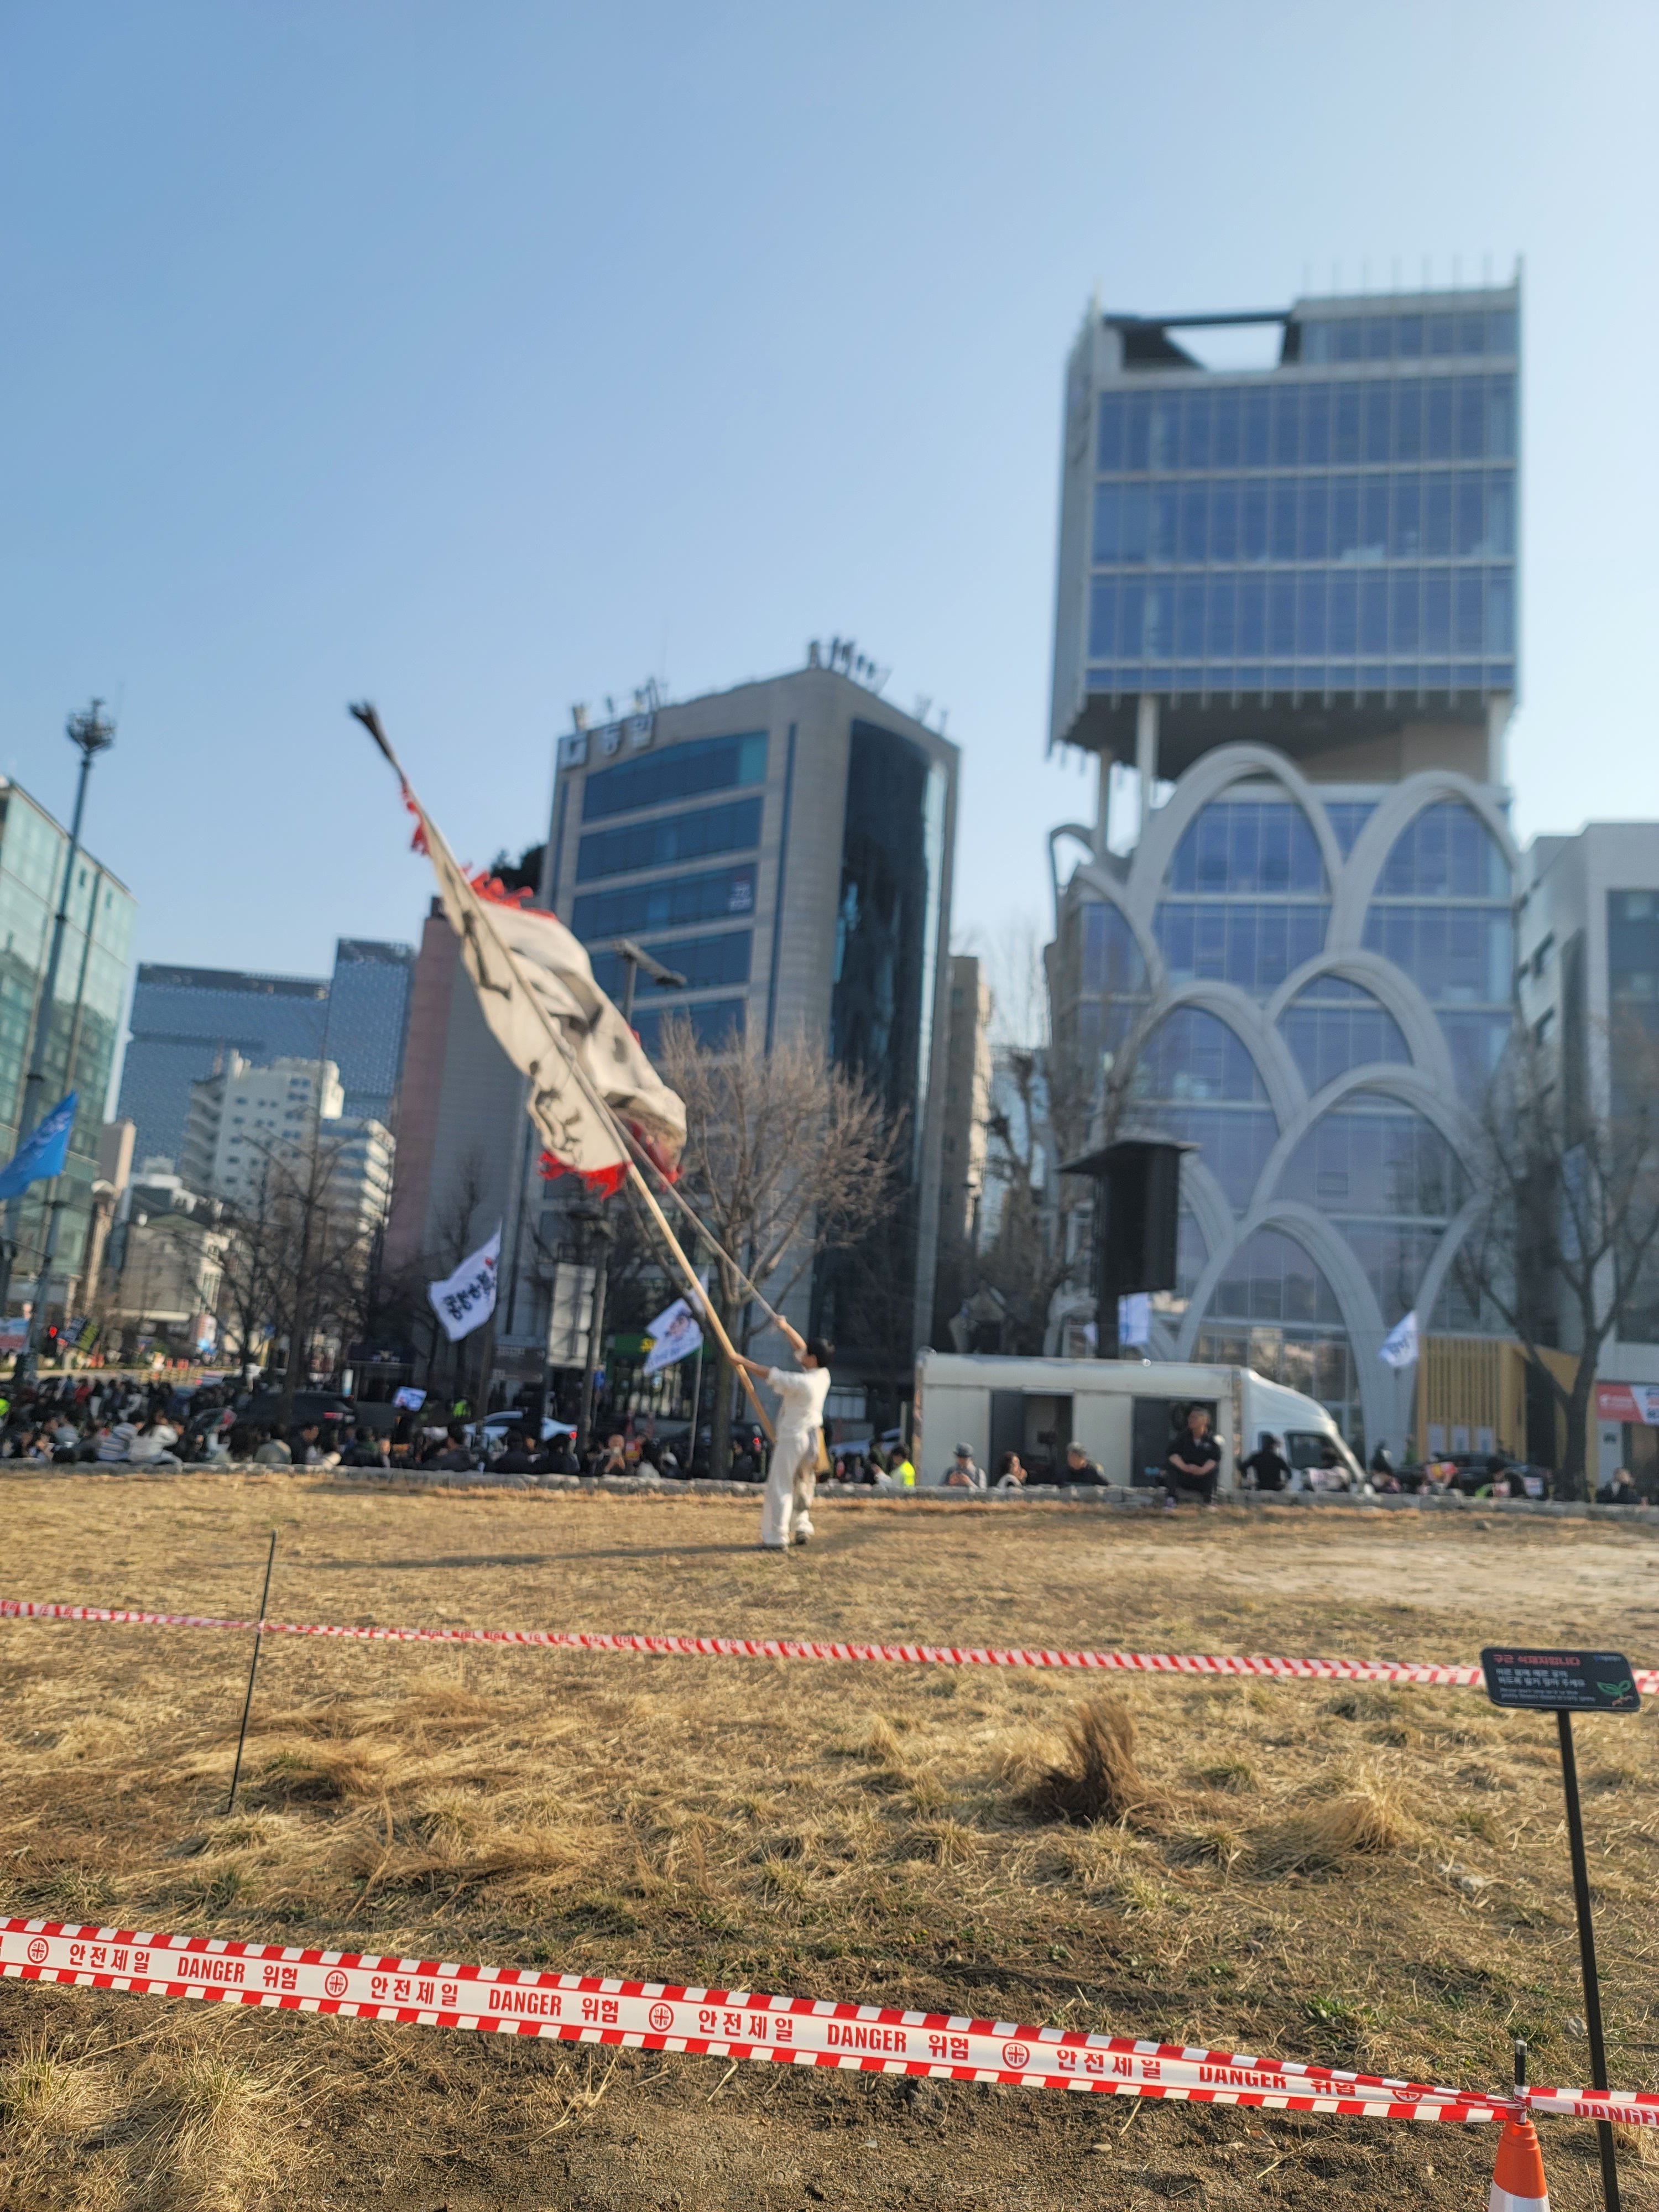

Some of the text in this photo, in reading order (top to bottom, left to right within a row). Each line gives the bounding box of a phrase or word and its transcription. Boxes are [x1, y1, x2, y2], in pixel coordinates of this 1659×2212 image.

[69, 1943, 151, 1974] 안전제일
[176, 1956, 246, 1989] DANGER
[262, 1964, 299, 1991] 위험
[371, 1976, 458, 2007] 안전제일
[488, 1988, 562, 2017] DANGER
[581, 1997, 619, 2025] 위험
[698, 2009, 794, 2043] 안전제일
[827, 2023, 907, 2053] DANGER
[928, 2034, 971, 2061] 위험
[1056, 2049, 1161, 2080] 안전제일
[1198, 2065, 1287, 2089] DANGER
[1574, 2101, 1659, 2127] DANGE
